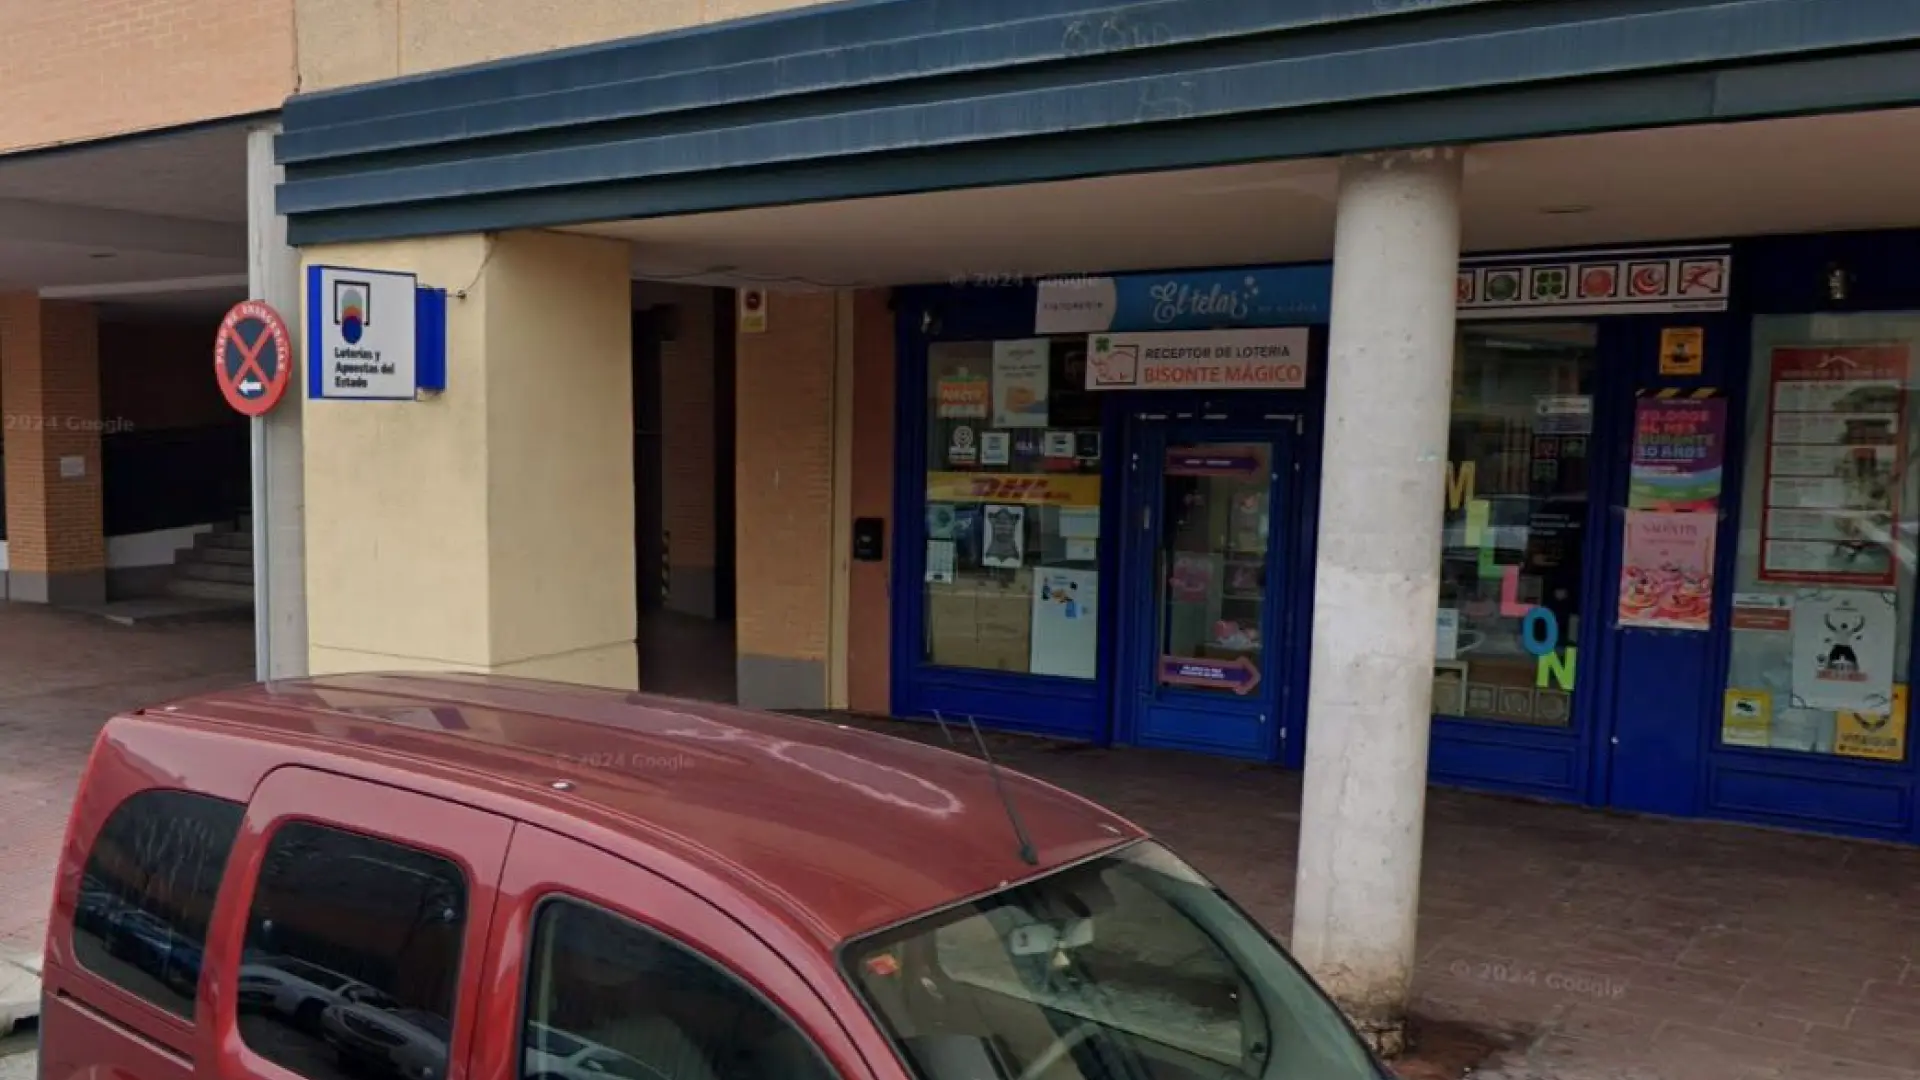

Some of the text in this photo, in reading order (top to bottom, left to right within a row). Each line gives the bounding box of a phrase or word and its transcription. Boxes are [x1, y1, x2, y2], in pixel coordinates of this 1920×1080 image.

[1150, 281, 1248, 323] El telar
[1145, 346, 1211, 359] RECEPTOR
[1215, 346, 1231, 358] DE
[335, 361, 395, 376] Apuestas del
[1144, 361, 1302, 383] BISONTE MÁGICO
[334, 375, 368, 388] Estado
[970, 477, 1052, 498] DHL
